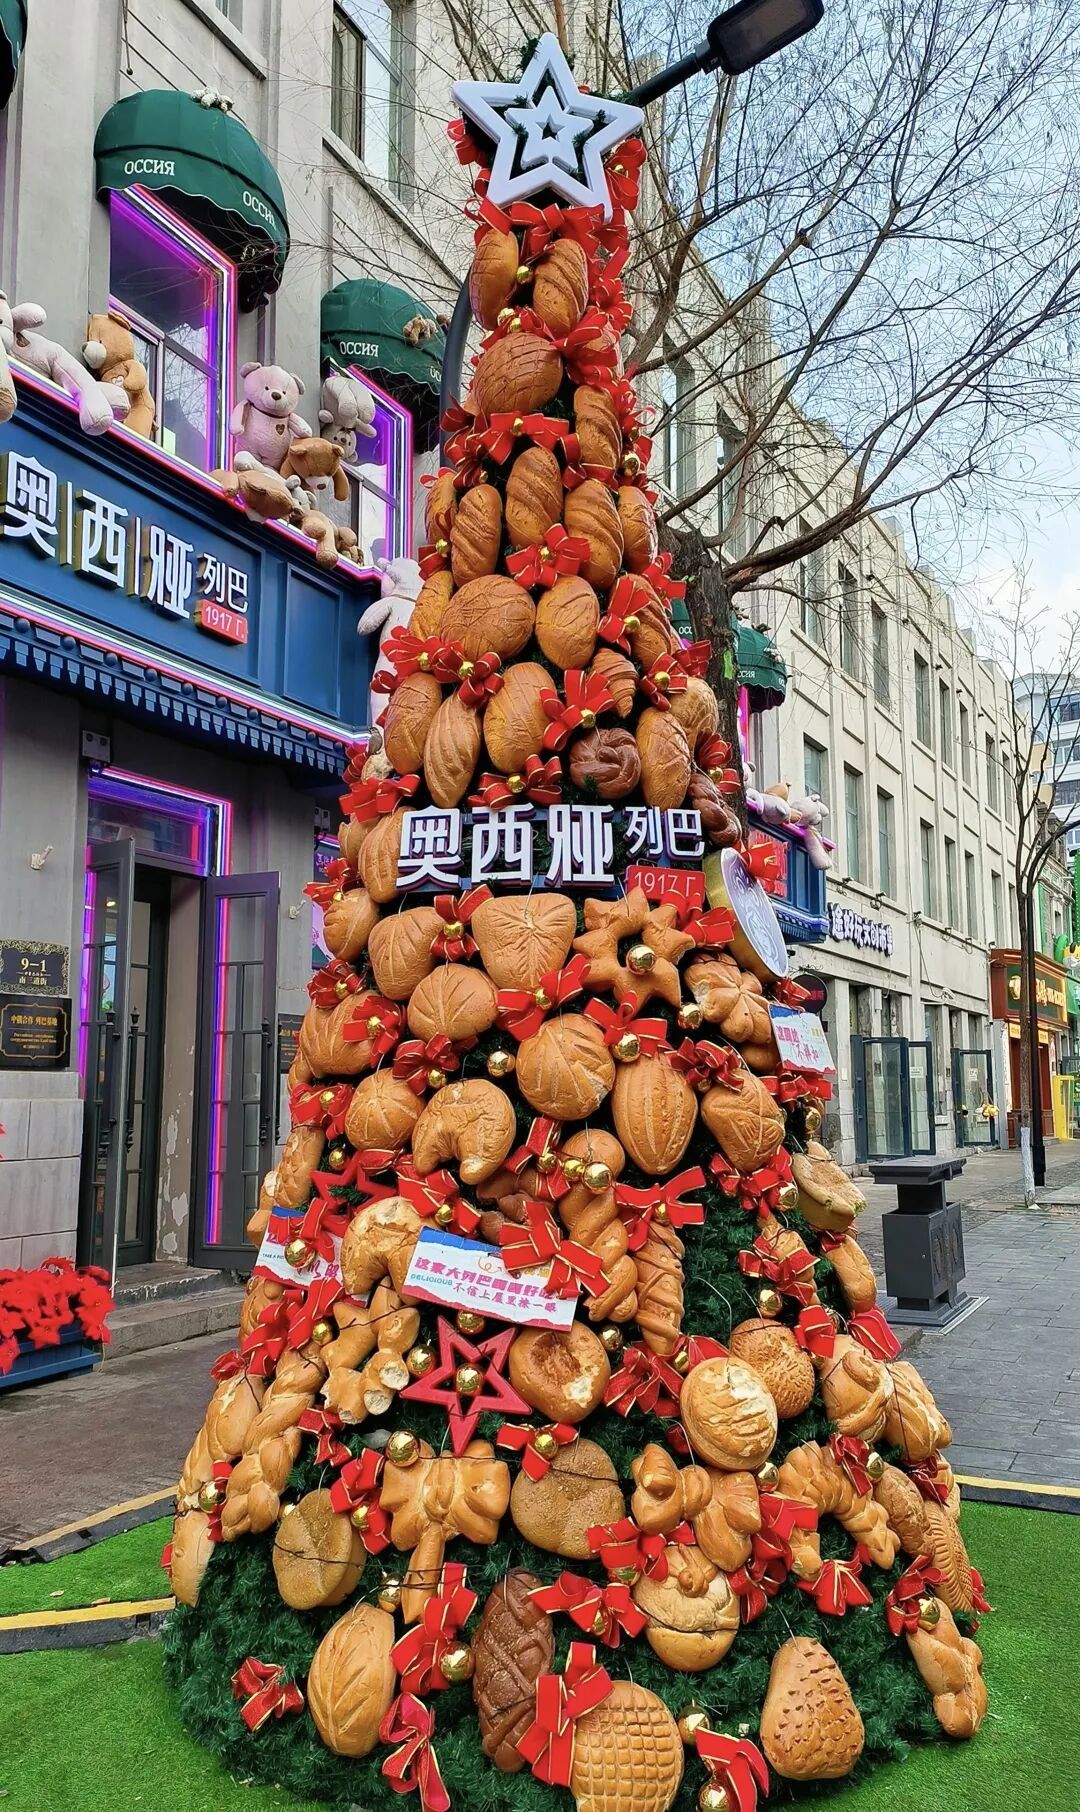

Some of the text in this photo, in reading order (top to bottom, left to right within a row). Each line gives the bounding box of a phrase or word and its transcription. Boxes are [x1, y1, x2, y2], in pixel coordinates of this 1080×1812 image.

[340, 341, 379, 358] ОССИЯ
[203, 553, 248, 613] 列巴
[205, 606, 232, 635] 1917
[625, 806, 705, 857] 列巴
